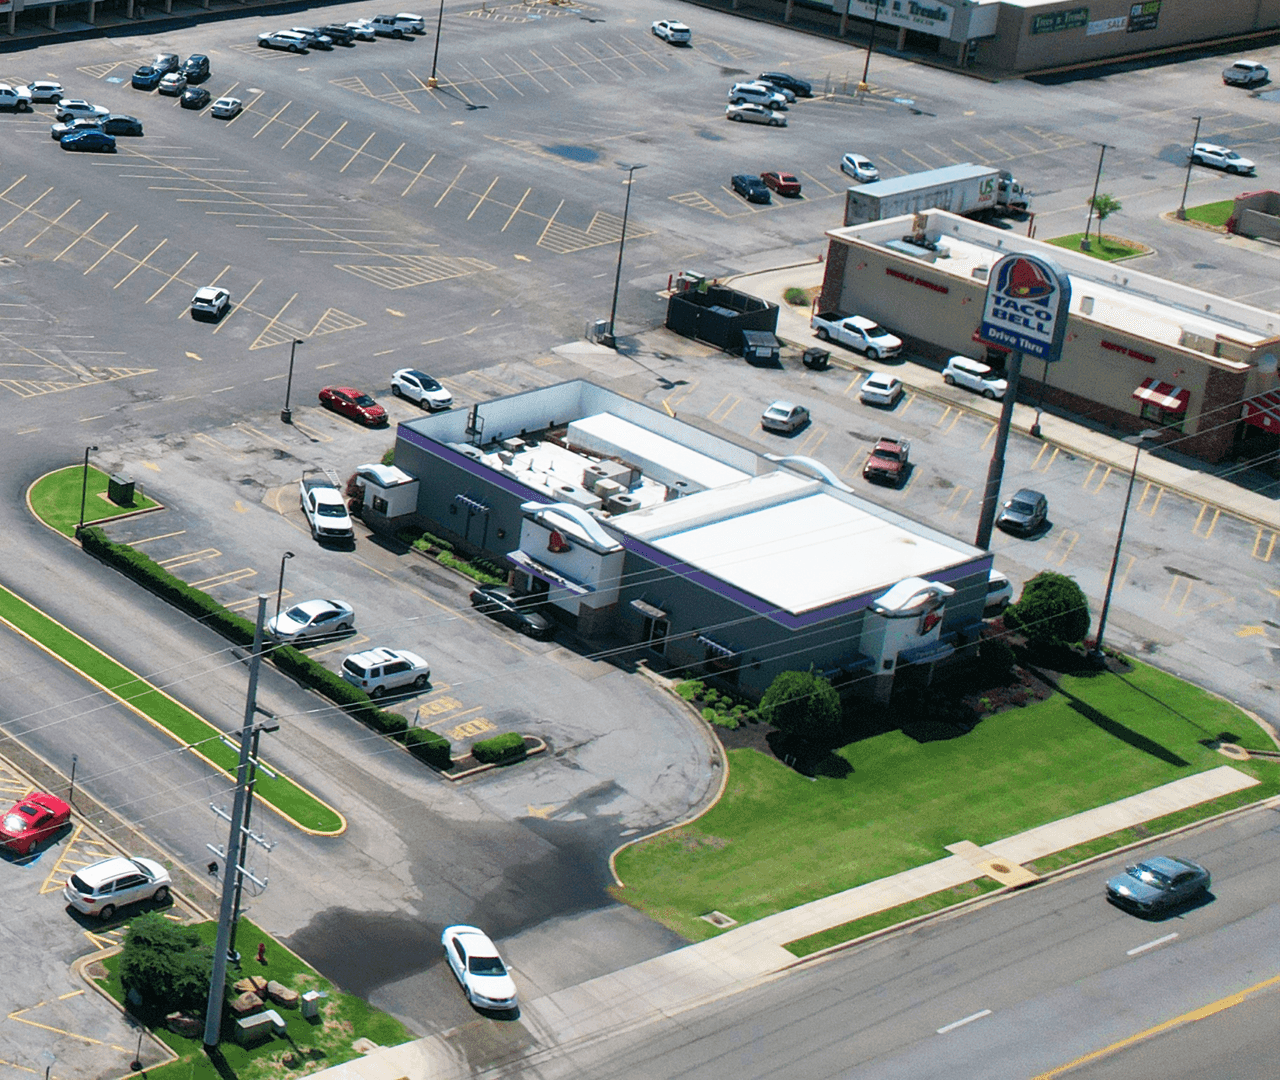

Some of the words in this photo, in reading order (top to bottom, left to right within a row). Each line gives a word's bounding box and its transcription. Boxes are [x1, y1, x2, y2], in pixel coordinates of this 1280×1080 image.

[991, 294, 1052, 321] TACO
[992, 307, 1050, 335] BELL
[988, 328, 1017, 344] Drive
[1020, 338, 1043, 353] Thru
